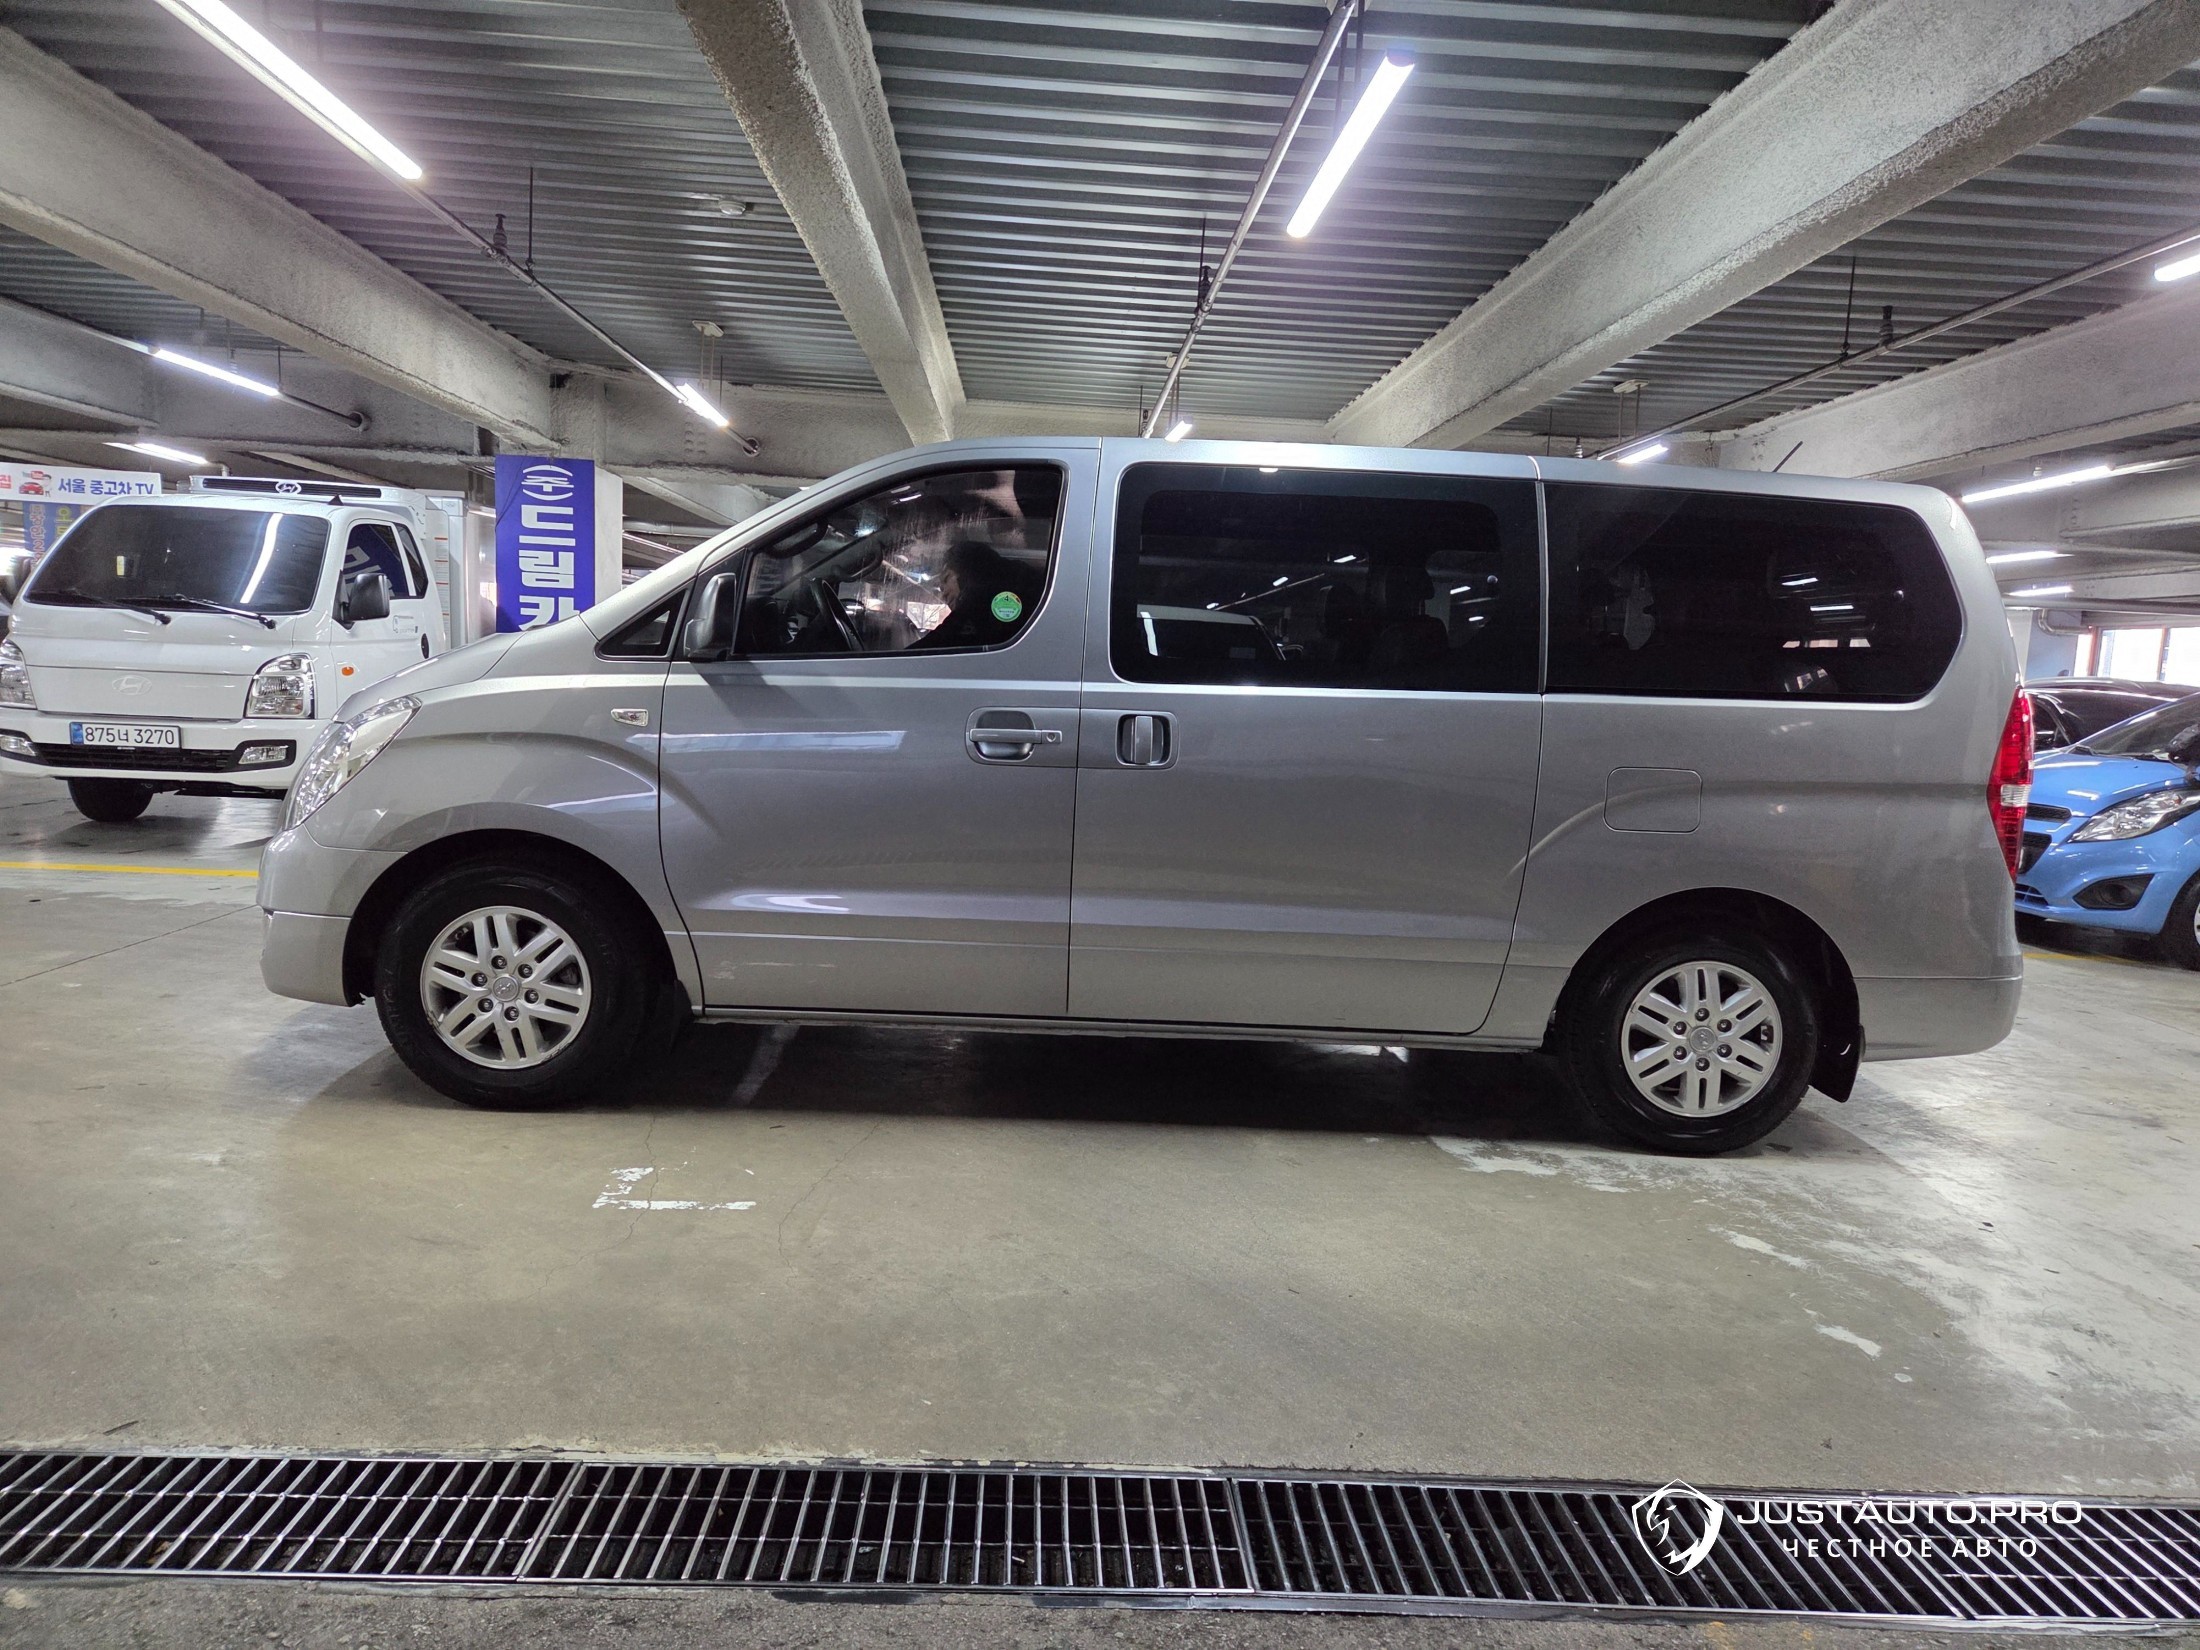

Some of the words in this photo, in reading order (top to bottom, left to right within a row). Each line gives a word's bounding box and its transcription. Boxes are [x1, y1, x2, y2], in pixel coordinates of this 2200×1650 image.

[58, 478, 85, 494] 서울
[90, 480, 132, 495] 중고차
[136, 483, 154, 495] TV
[85, 727, 129, 742] 875너
[134, 729, 174, 745] 3270
